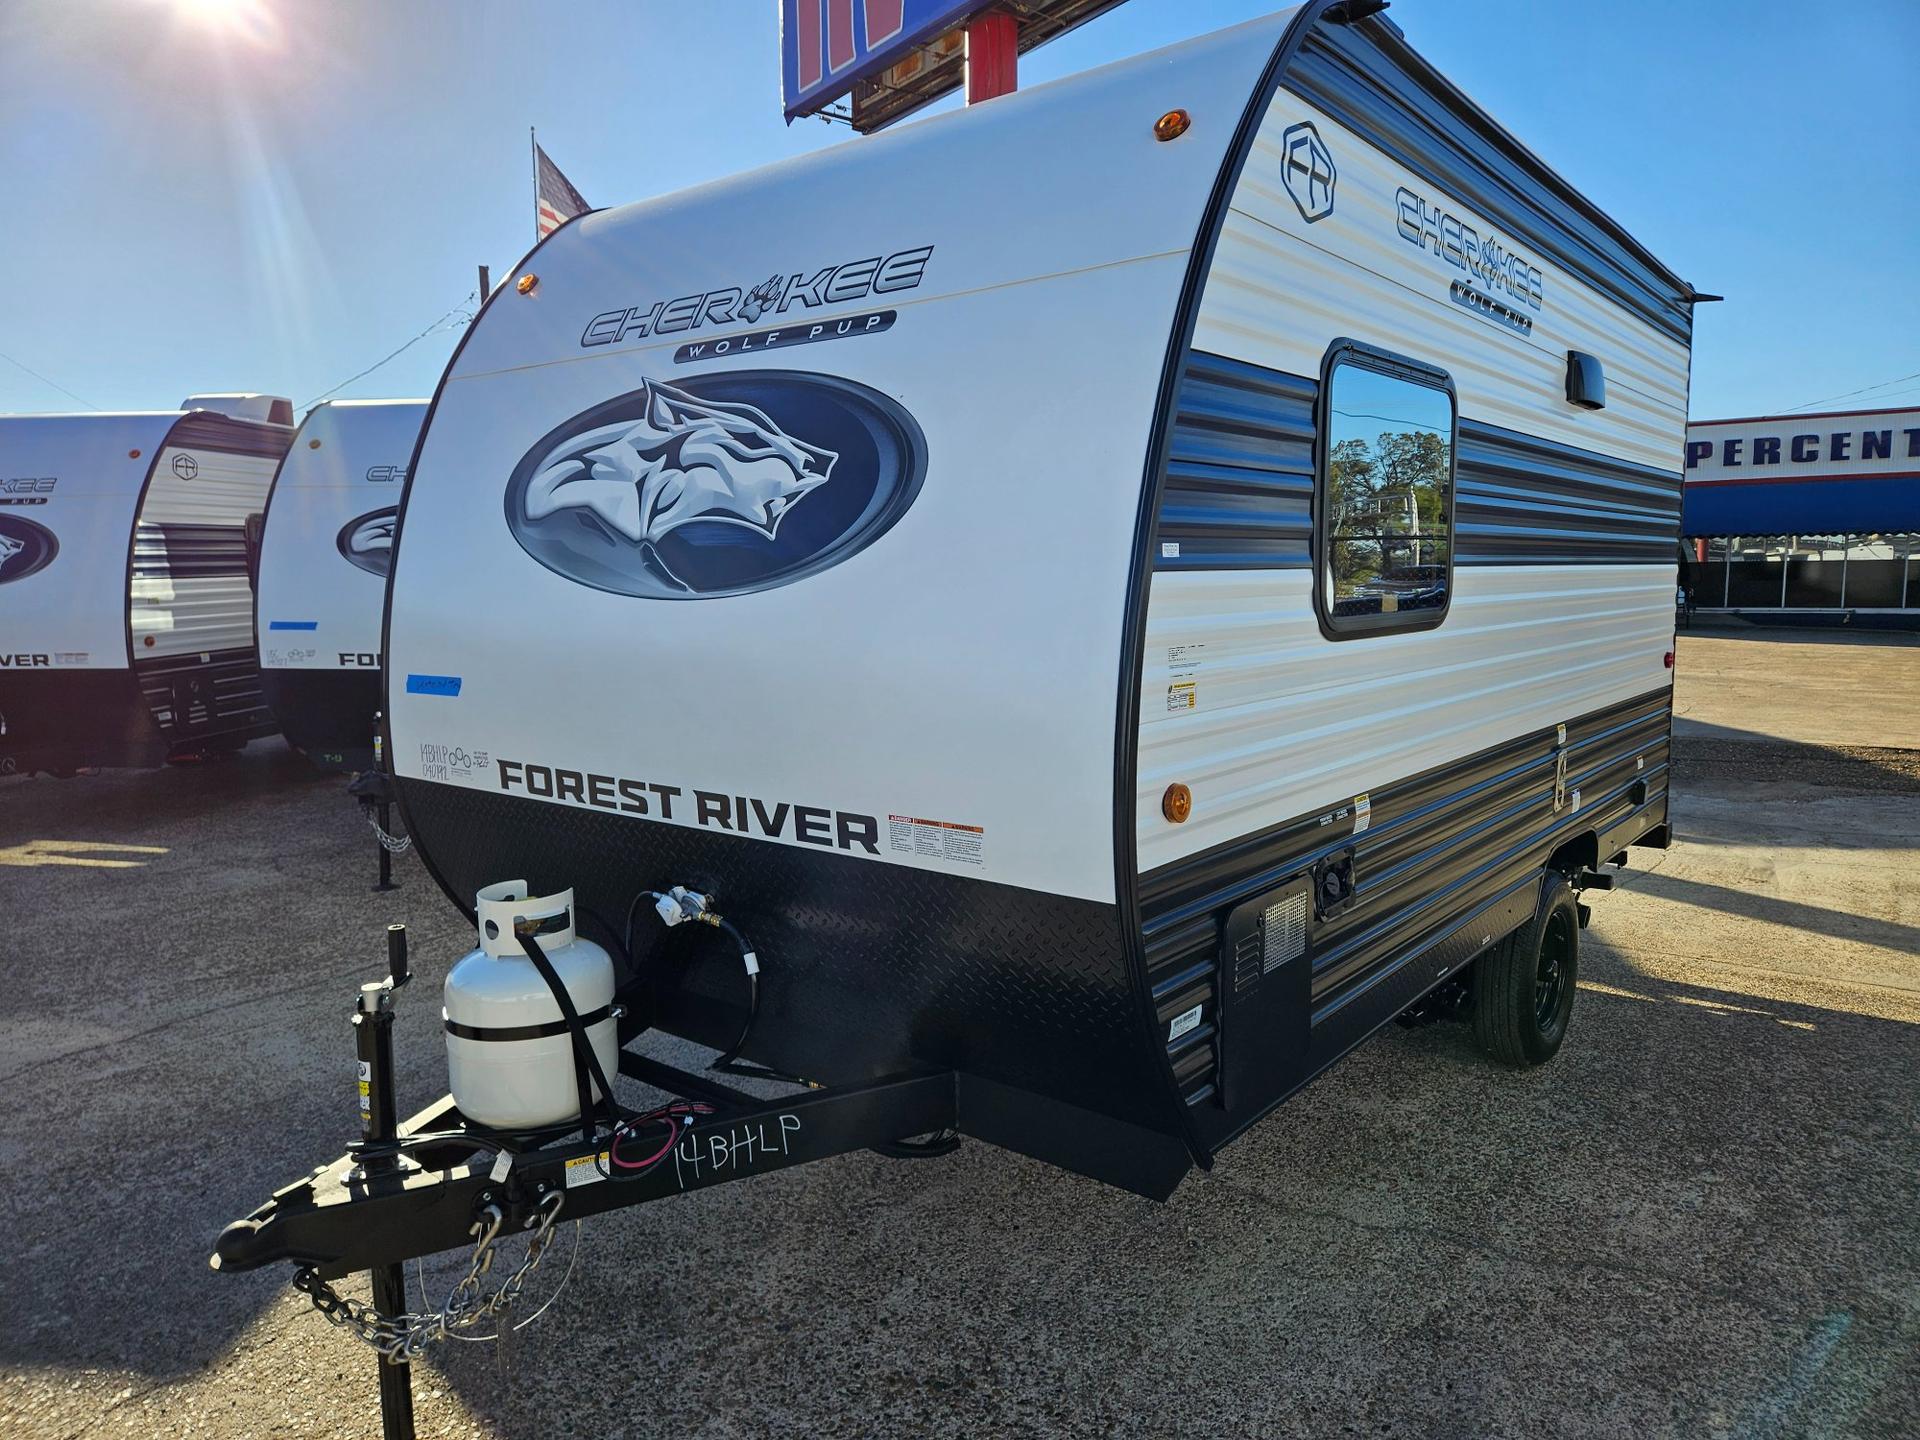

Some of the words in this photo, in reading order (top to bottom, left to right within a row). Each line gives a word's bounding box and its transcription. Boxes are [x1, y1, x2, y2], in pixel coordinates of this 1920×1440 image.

[1456, 285, 1497, 315] WOLF
[1504, 311, 1529, 330] PUP
[688, 333, 780, 358] WOLF
[808, 315, 882, 339] PUP
[1686, 428, 1920, 469] PERCENT
[338, 652, 381, 666] FO
[496, 758, 682, 819] FOREST
[693, 789, 882, 855] RIVER
[675, 1114, 801, 1189] 14BHLP
